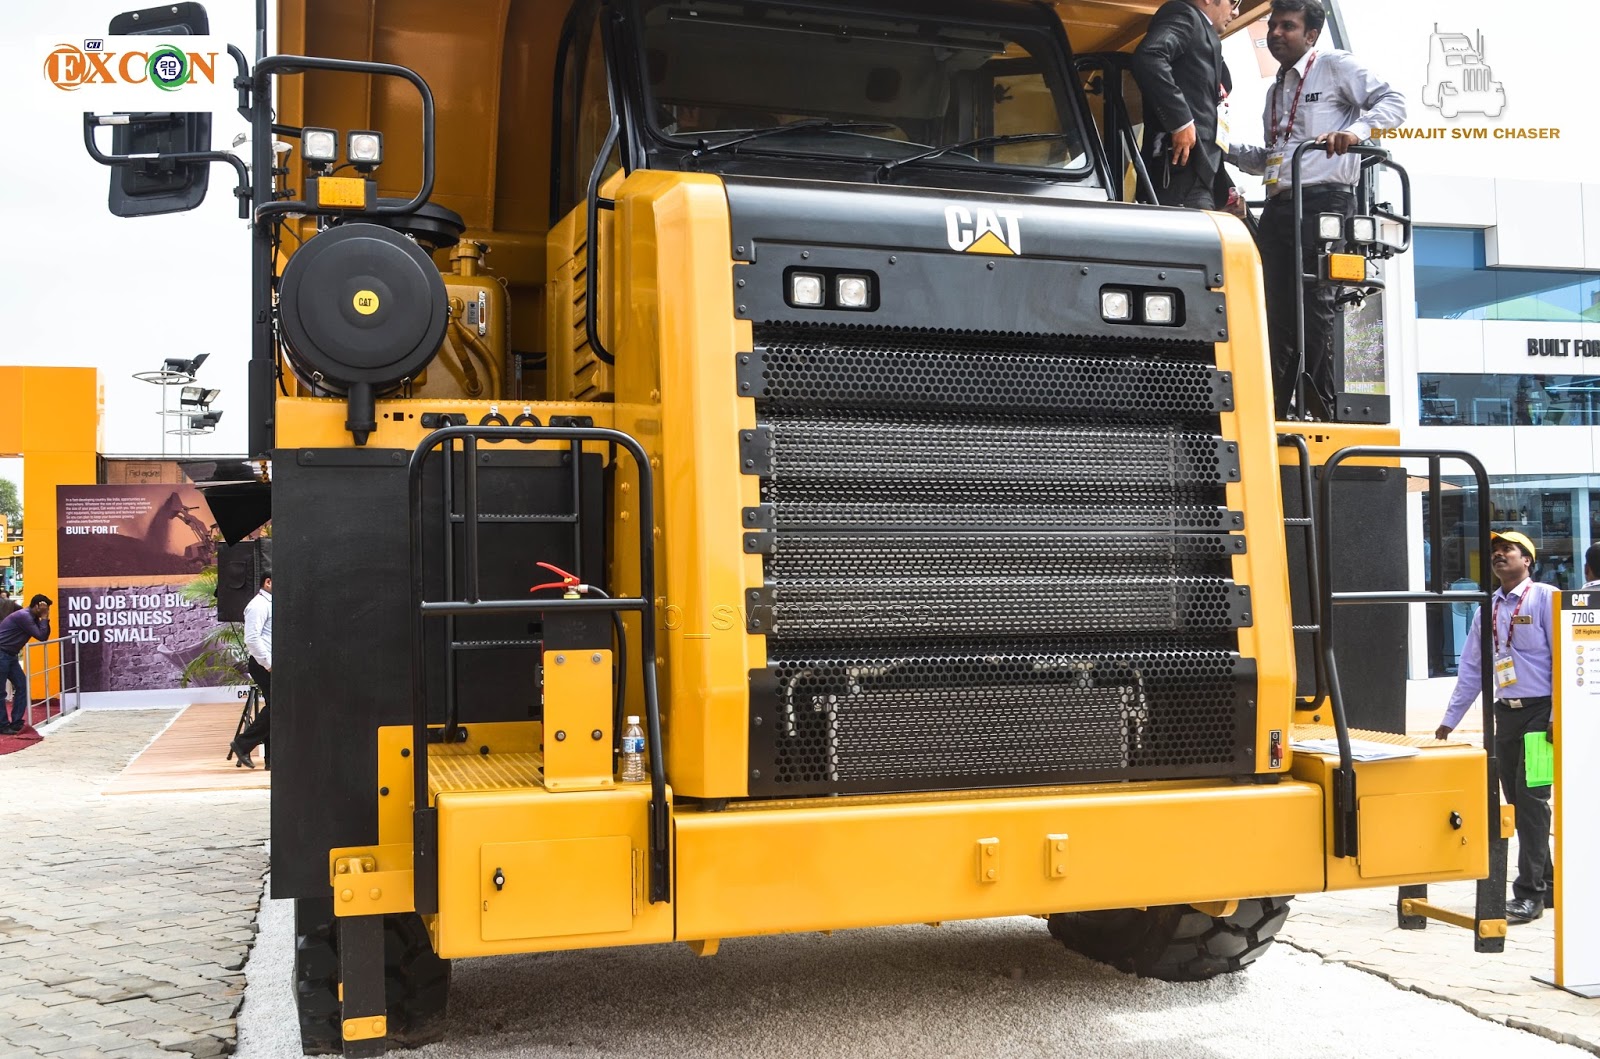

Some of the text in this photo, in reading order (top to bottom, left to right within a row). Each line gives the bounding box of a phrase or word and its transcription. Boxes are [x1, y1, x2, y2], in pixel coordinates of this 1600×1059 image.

[1305, 92, 1319, 103] CAT
[944, 205, 1023, 255] CAT
[359, 297, 372, 306] CAT
[1527, 338, 1600, 357] BUILT FOR
[66, 525, 119, 535] BUILT FOR IT.
[68, 596, 91, 611] NO
[95, 595, 126, 610] JOB
[130, 594, 161, 609] TOO
[1571, 593, 1590, 607] CAT
[68, 610, 173, 627] NO BUSINESS
[1572, 612, 1595, 623] 770G
[68, 628, 160, 644] TOO SMALL.
